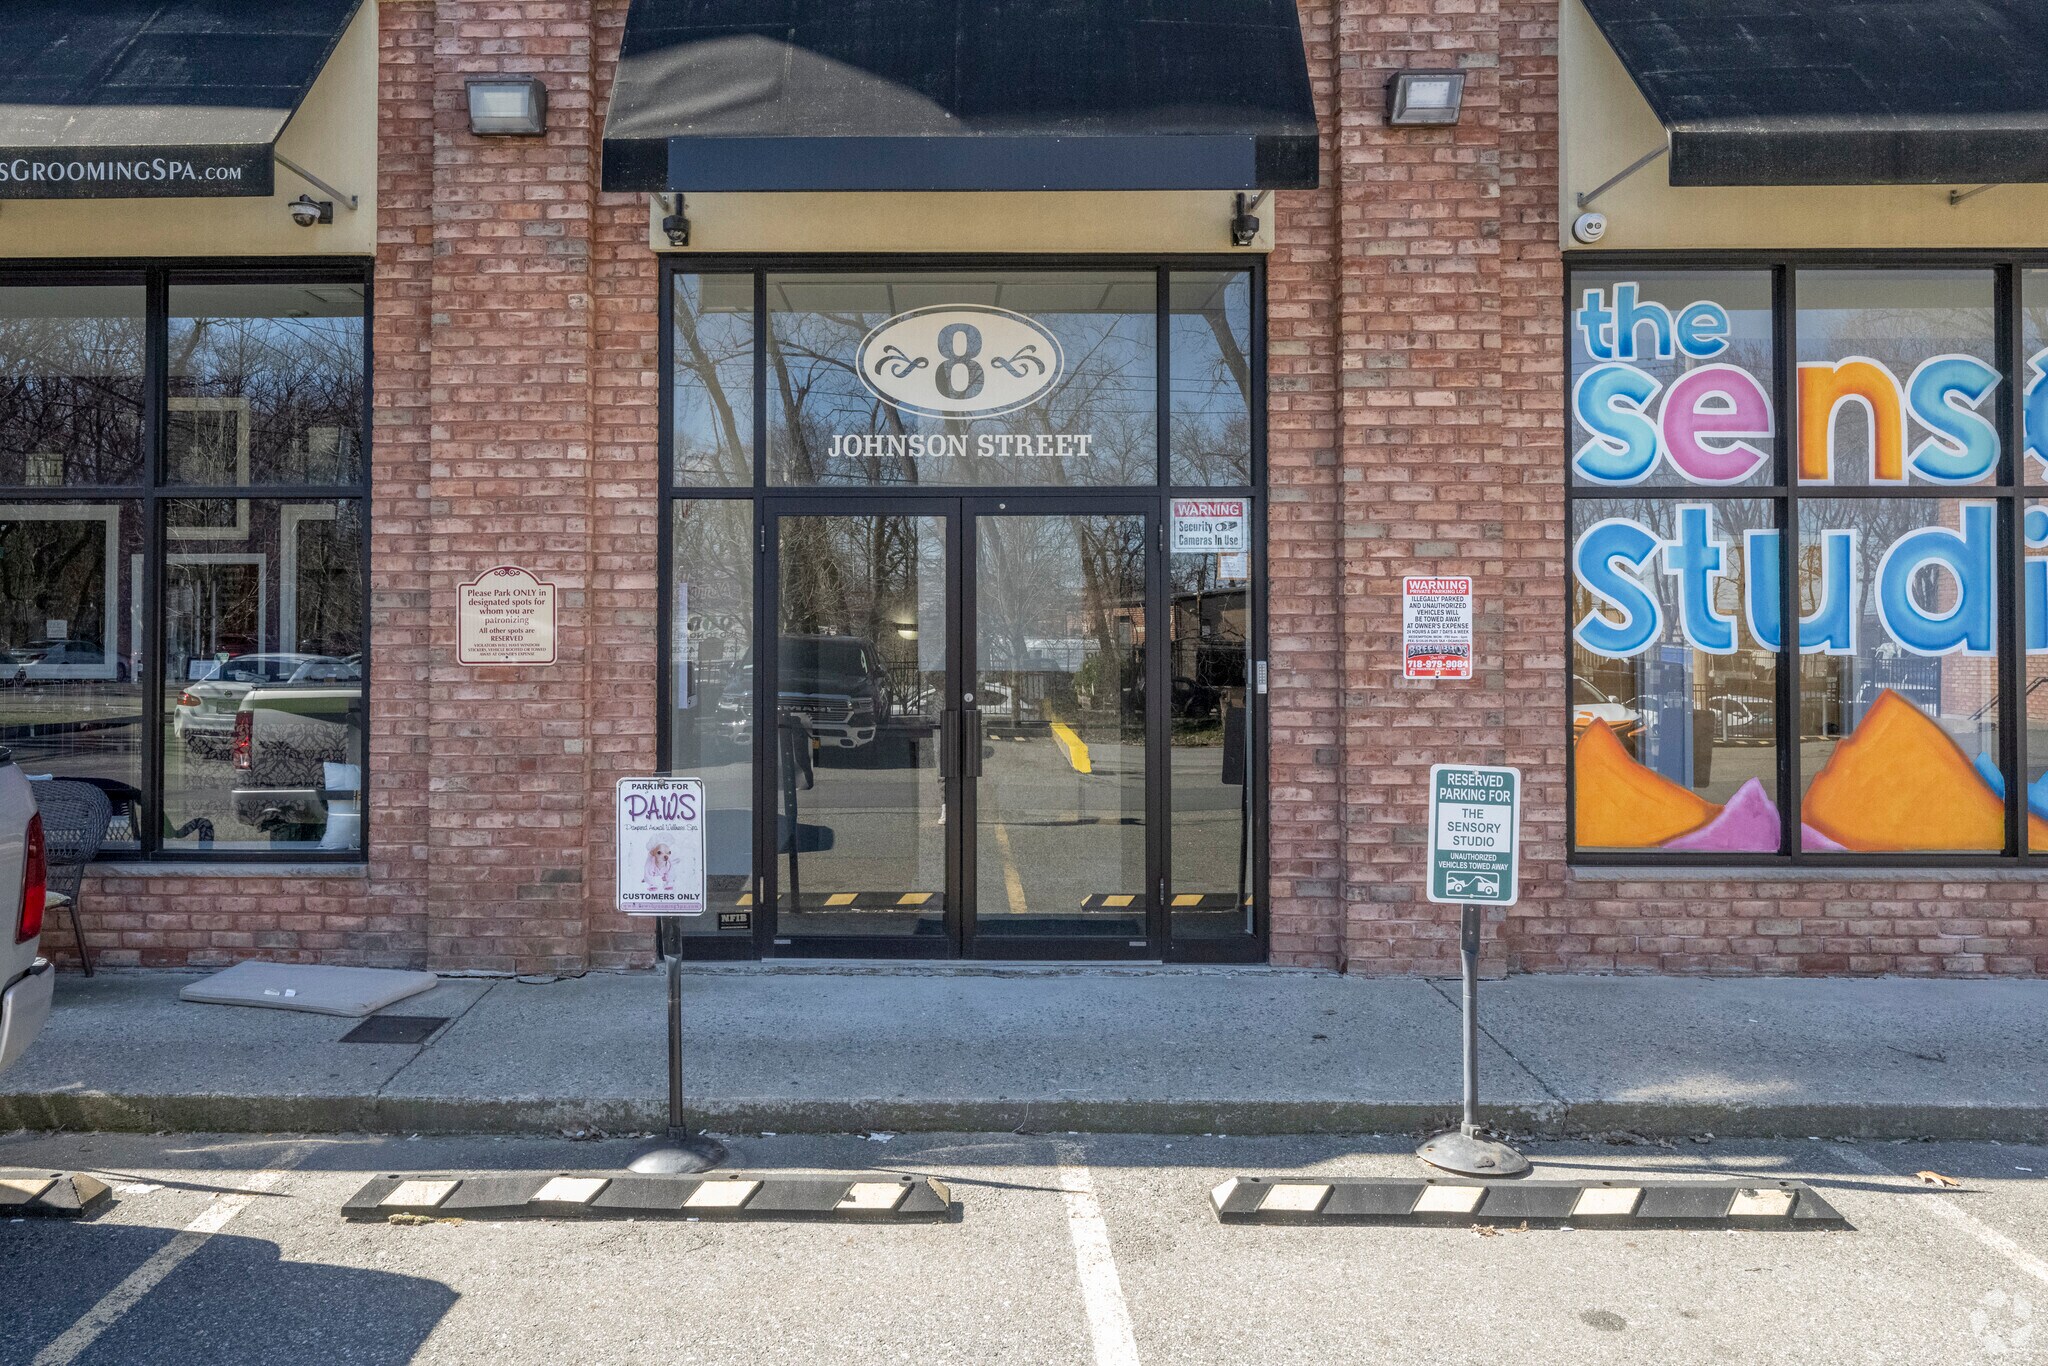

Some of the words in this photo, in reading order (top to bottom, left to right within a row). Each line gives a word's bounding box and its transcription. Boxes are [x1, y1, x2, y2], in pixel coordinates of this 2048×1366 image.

[1576, 281, 1731, 362] the
[935, 323, 985, 400] 8
[828, 435, 968, 457] JOHNSON
[978, 435, 1092, 457] STREET
[1178, 504, 1239, 515] WARNING
[1179, 521, 1212, 533] Security
[1179, 535, 1212, 545] Cameras
[1215, 535, 1222, 545] In
[1225, 535, 1238, 545] Use
[1409, 581, 1466, 589] WARNING
[468, 598, 509, 607] designated
[512, 599, 532, 607] spots
[485, 616, 529, 625] patronizing
[1448, 773, 1503, 787] RESERVED
[1440, 788, 1486, 801] PARKING
[1489, 790, 1510, 802] FOR
[1462, 808, 1484, 819] THE
[1447, 821, 1501, 833] SENSORY
[1453, 835, 1495, 846] STUDIO
[1450, 853, 1496, 861] UNAUTHORIZED
[1438, 861, 1468, 869] VEHICLES
[721, 914, 747, 922] NFIB
